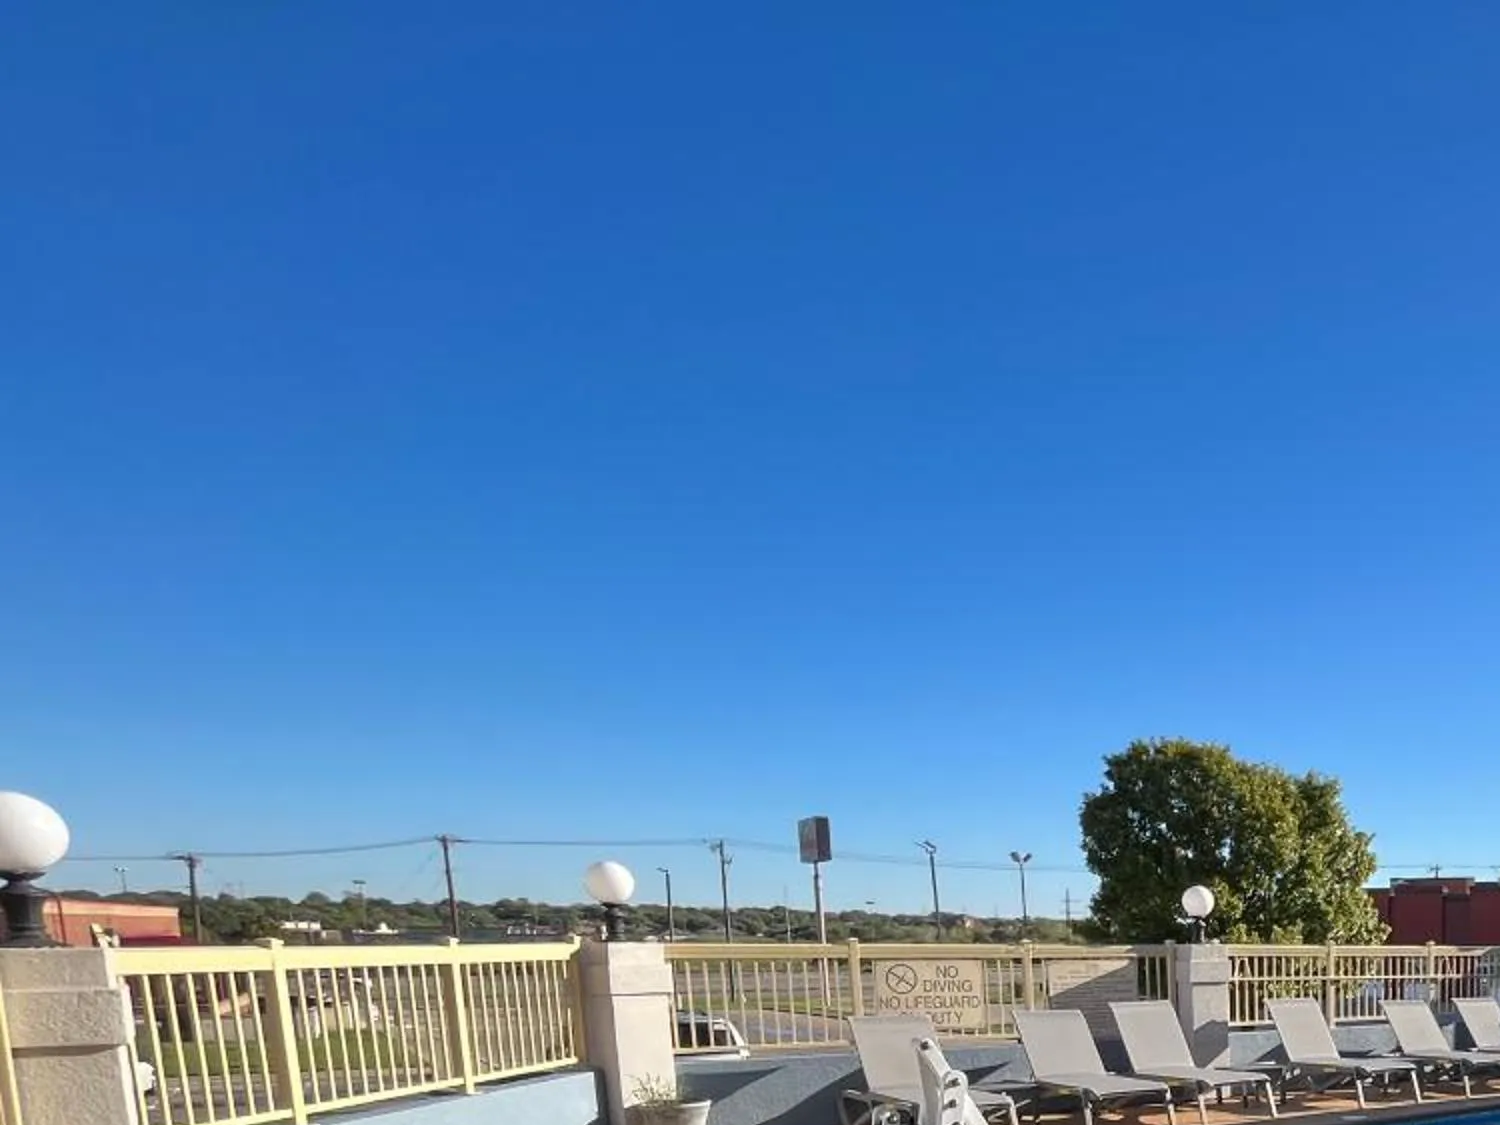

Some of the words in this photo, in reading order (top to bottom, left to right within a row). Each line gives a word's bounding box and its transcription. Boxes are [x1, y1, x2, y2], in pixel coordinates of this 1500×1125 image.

[936, 965, 959, 979] NO
[923, 979, 973, 993] DIVING
[879, 995, 901, 1010] NO
[905, 995, 980, 1009] LIFEGUARD
